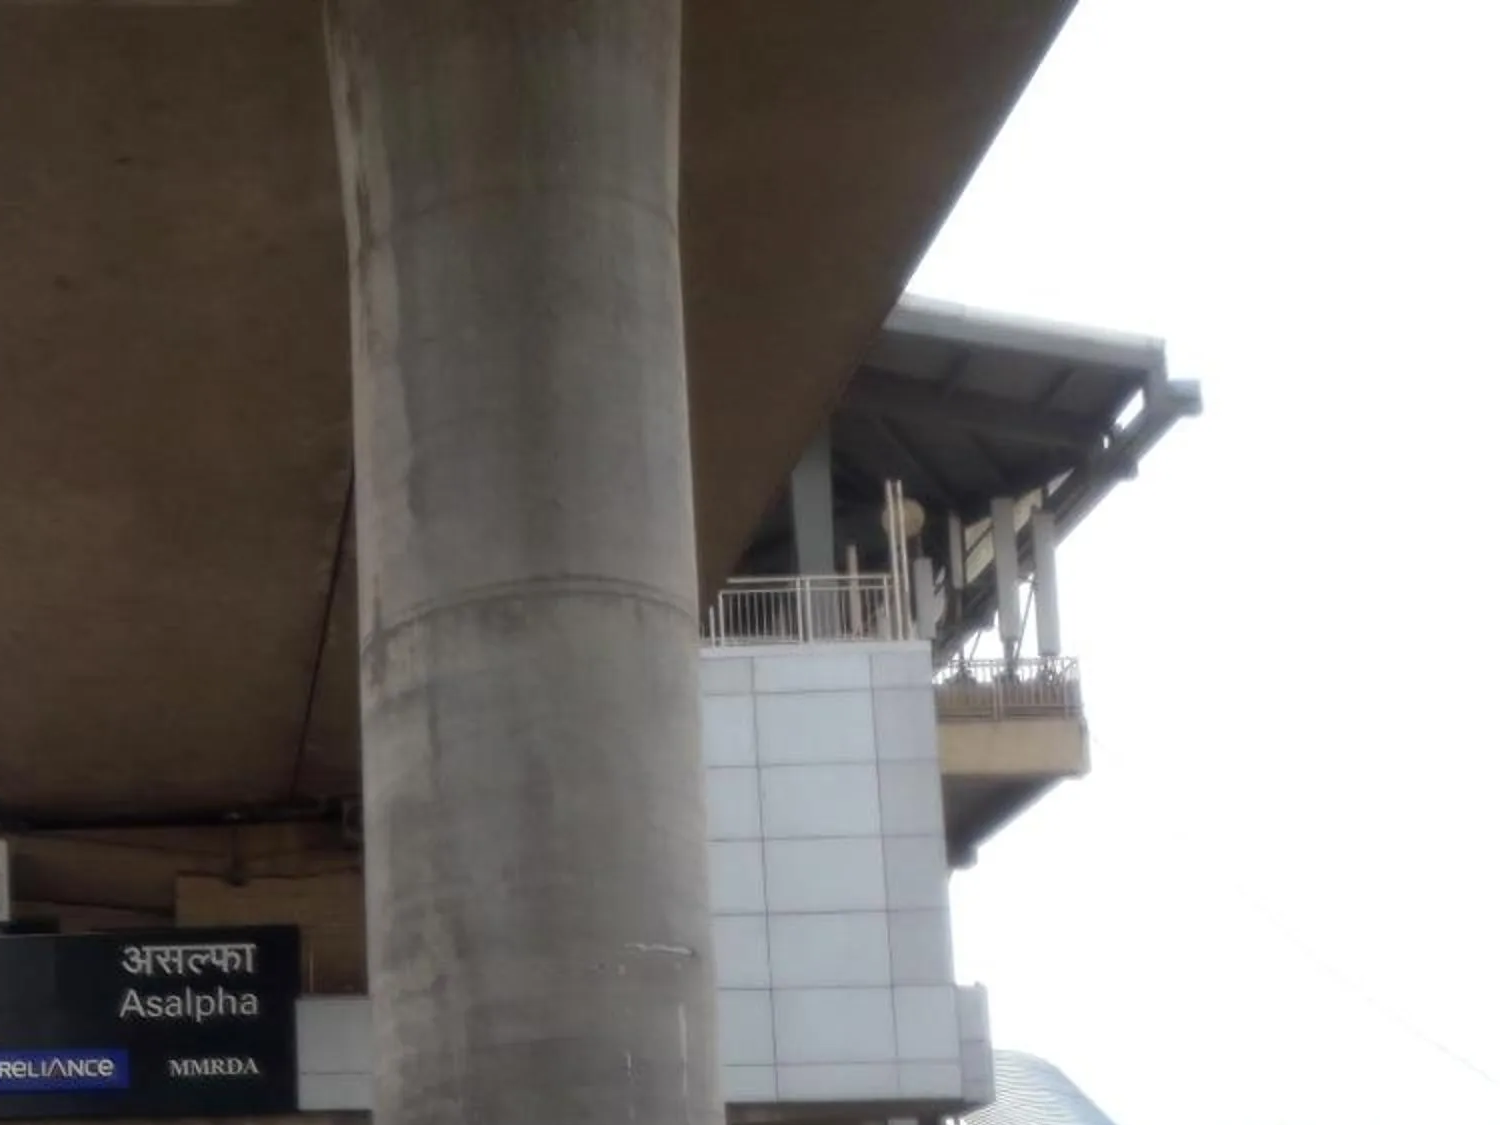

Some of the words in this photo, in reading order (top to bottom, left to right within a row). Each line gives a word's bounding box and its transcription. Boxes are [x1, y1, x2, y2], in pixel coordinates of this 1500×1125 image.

[122, 944, 257, 976] असल्फा
[119, 986, 258, 1023] Asalpha
[168, 1058, 260, 1076] MMRDA
